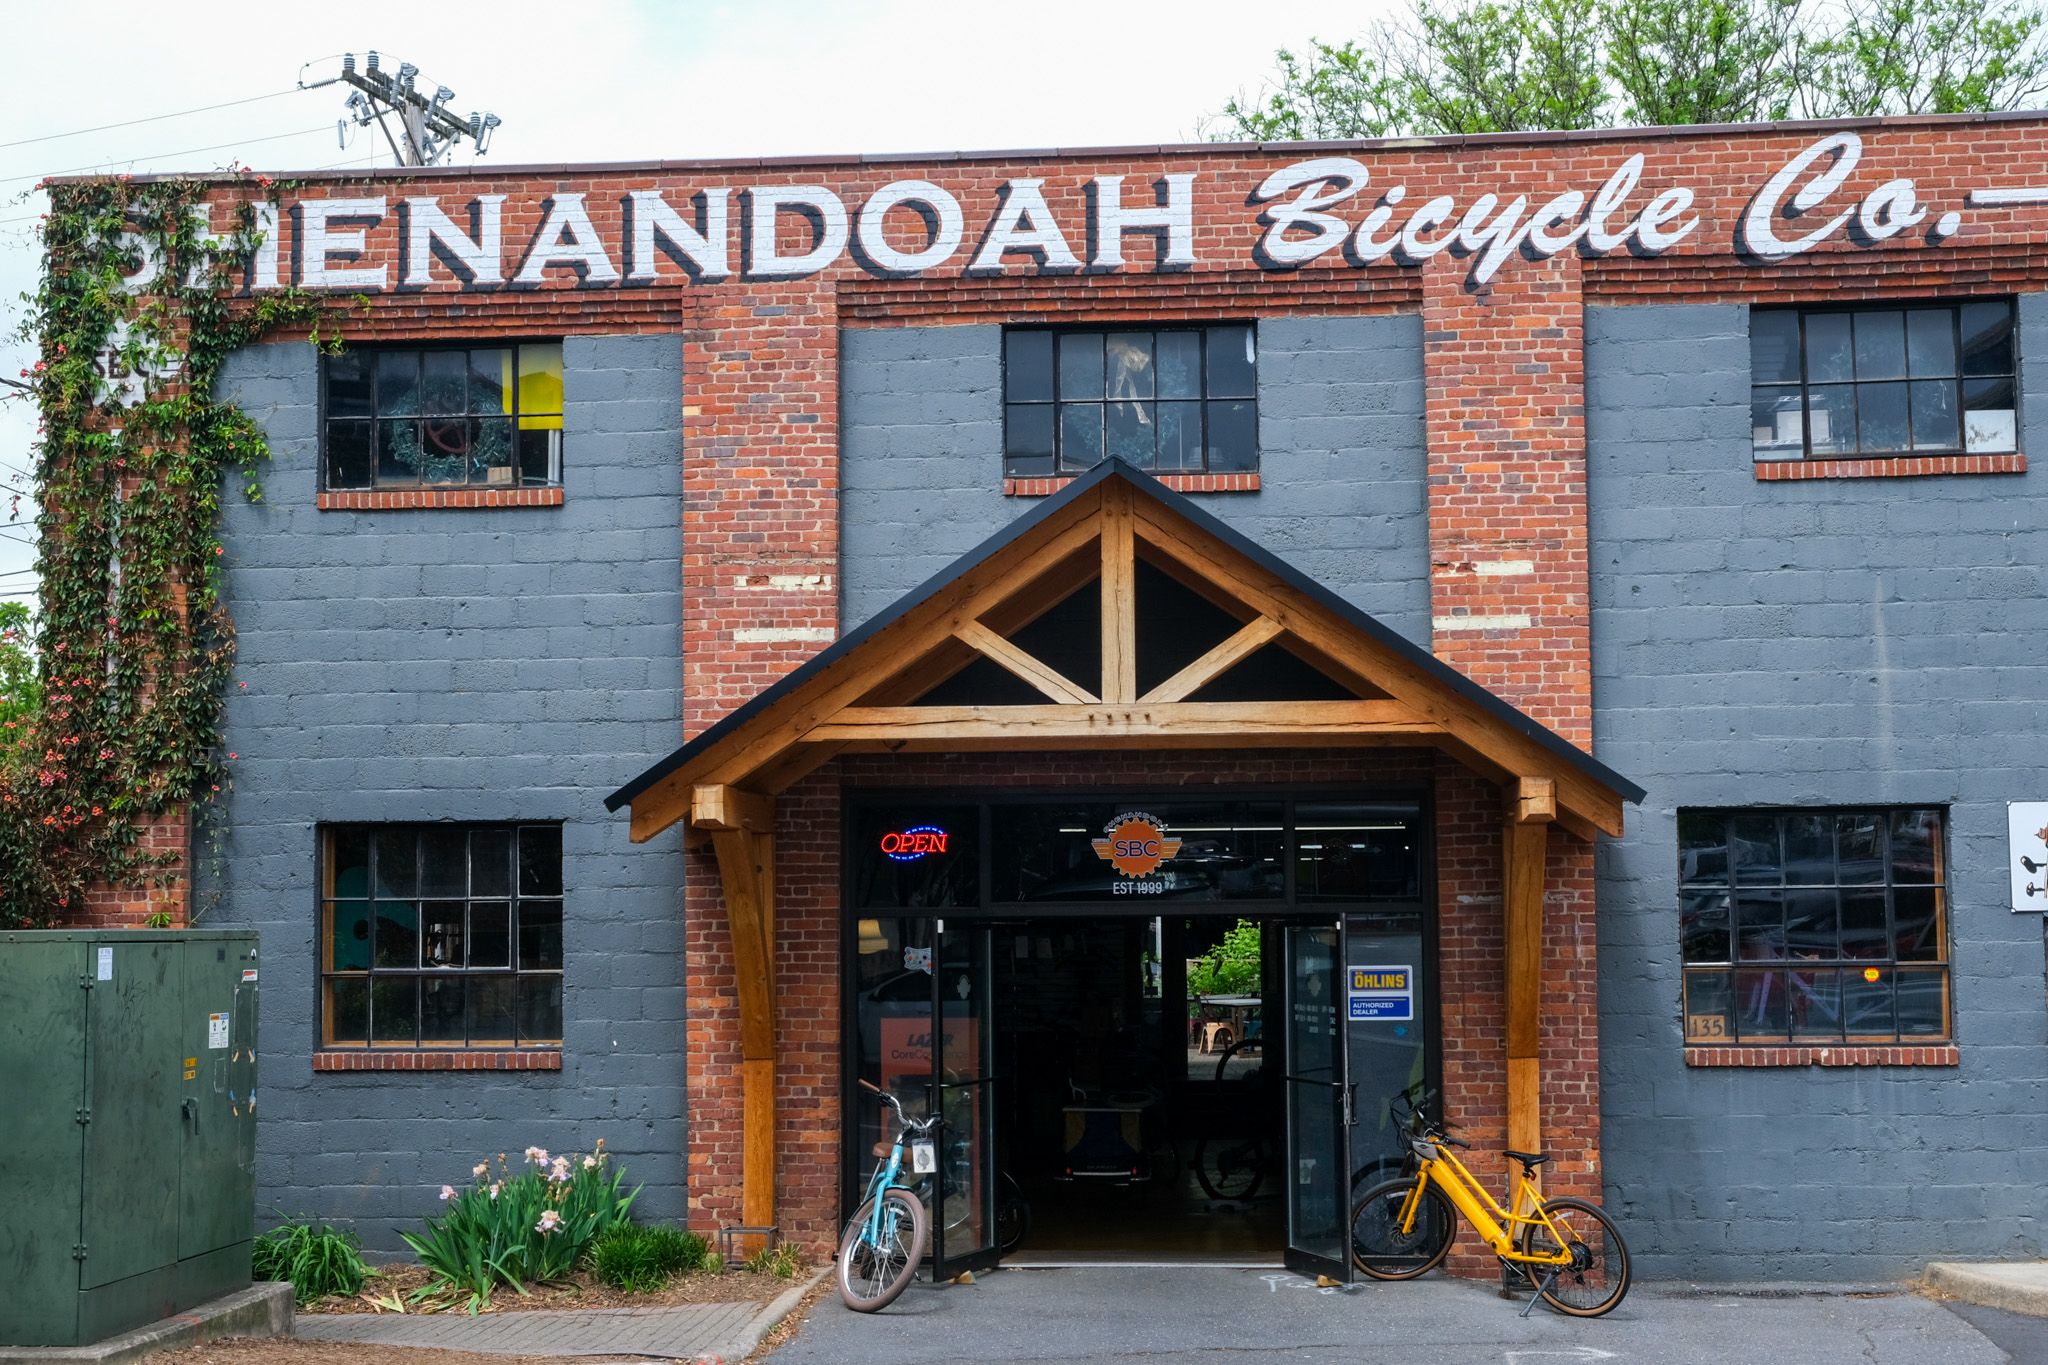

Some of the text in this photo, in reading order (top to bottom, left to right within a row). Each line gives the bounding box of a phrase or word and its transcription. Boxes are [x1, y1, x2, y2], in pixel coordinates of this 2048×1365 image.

[1255, 153, 1699, 286] Bicycle
[1742, 131, 1960, 262] Co.
[881, 833, 948, 853] OPEN
[1114, 839, 1159, 857] SBC
[1113, 882, 1163, 894] EST 1999
[1354, 971, 1405, 988] ÖHLINS
[1693, 1018, 1723, 1037] 135
